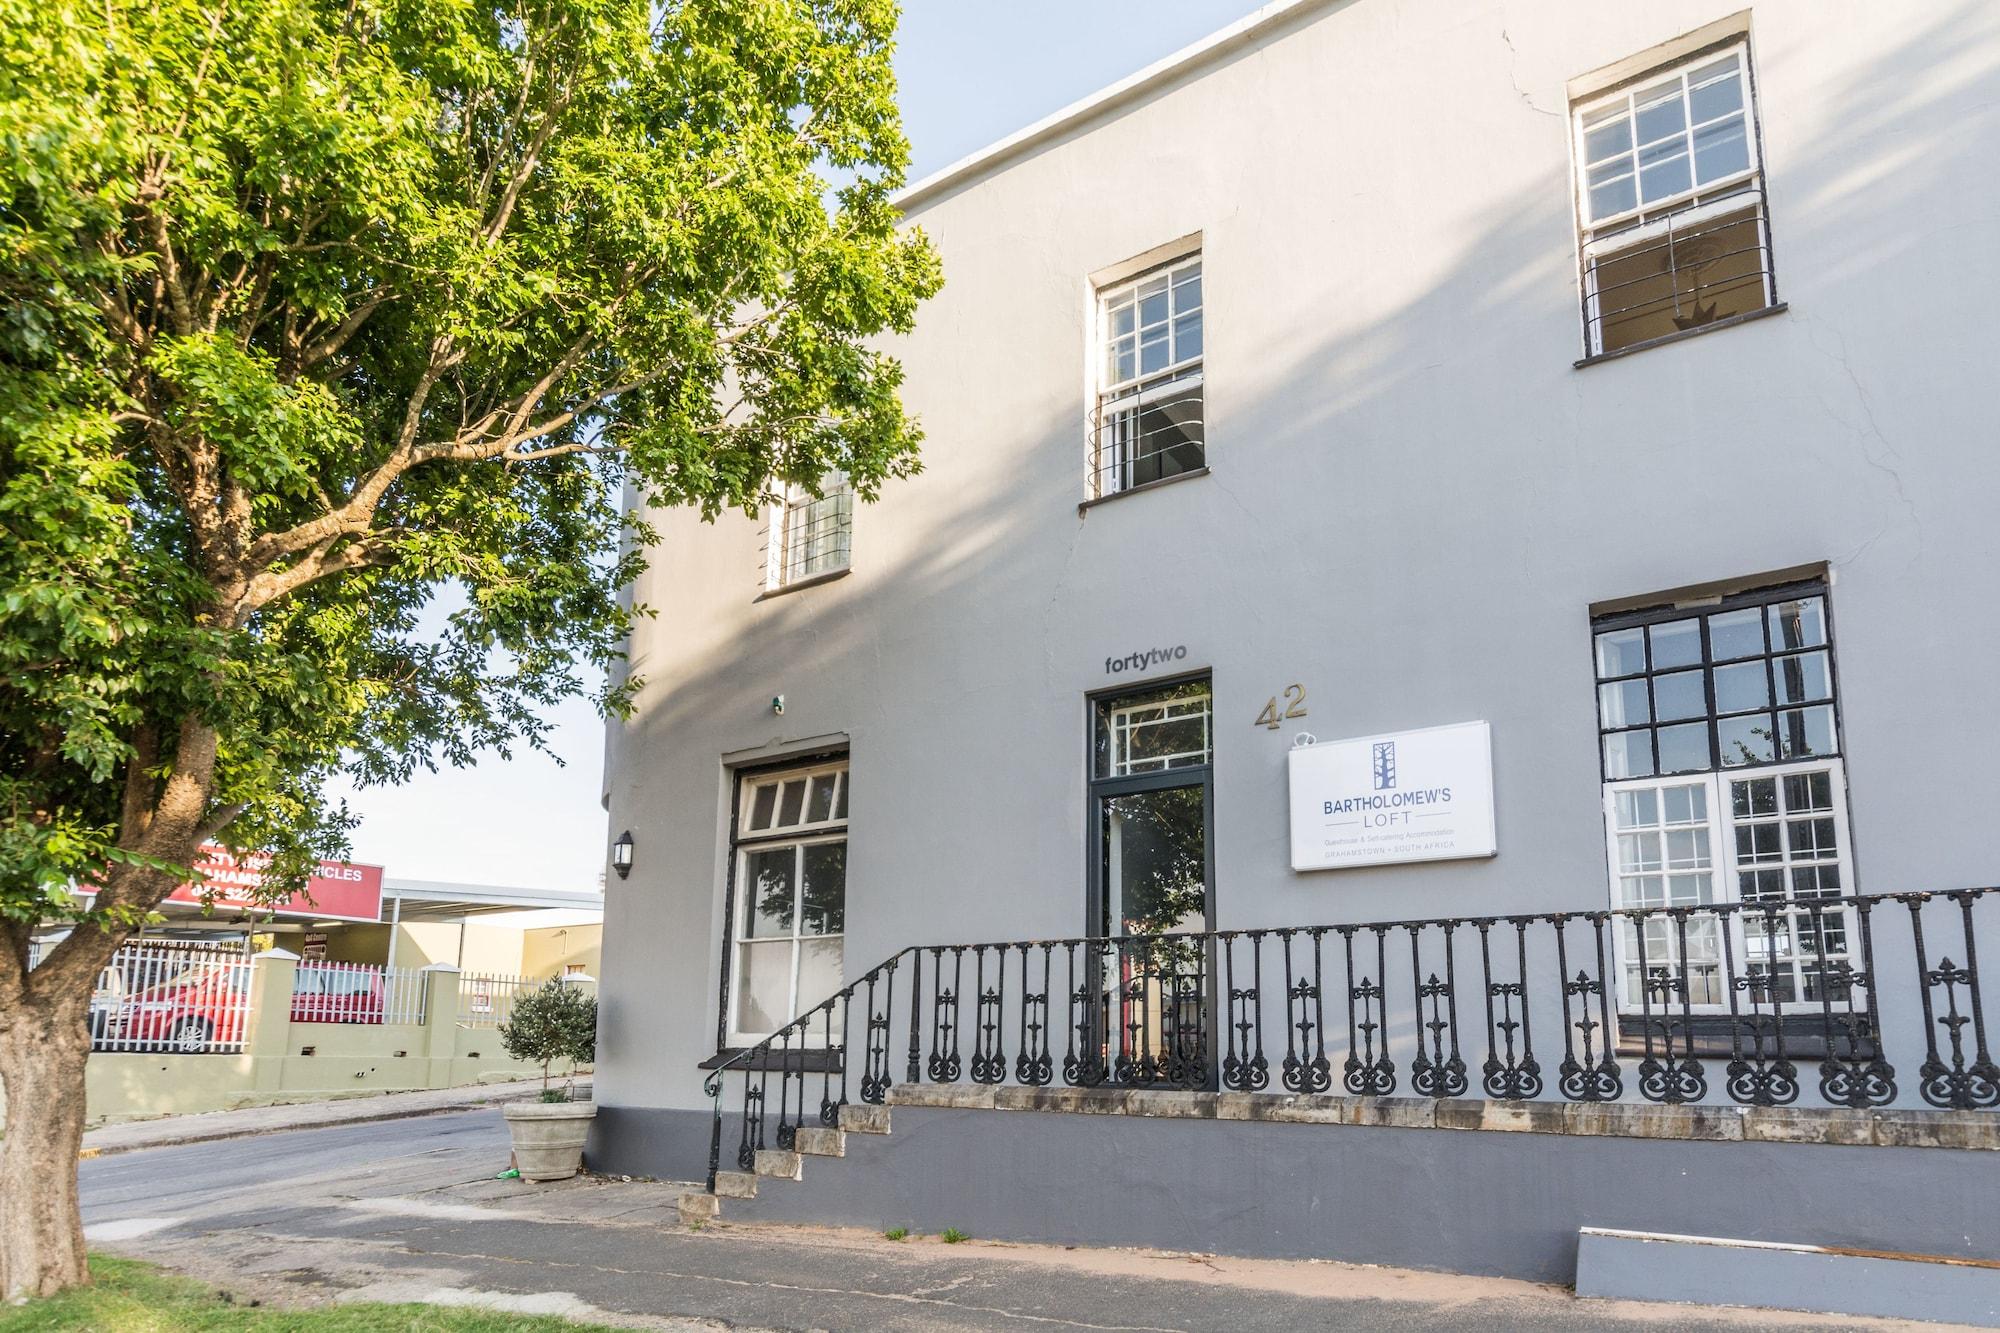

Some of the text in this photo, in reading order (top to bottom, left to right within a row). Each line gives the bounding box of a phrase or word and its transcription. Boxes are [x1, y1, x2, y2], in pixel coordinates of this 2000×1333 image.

[1105, 645, 1187, 674] fortytwo
[1254, 683, 1307, 730] 42
[1324, 788, 1452, 814] BARTHOLOMEW'S
[1364, 811, 1412, 828] LOFT
[1406, 829, 1455, 839] Accommodation
[1324, 841, 1455, 858] GRAHAMSTOWN SOUTH AFRICA
